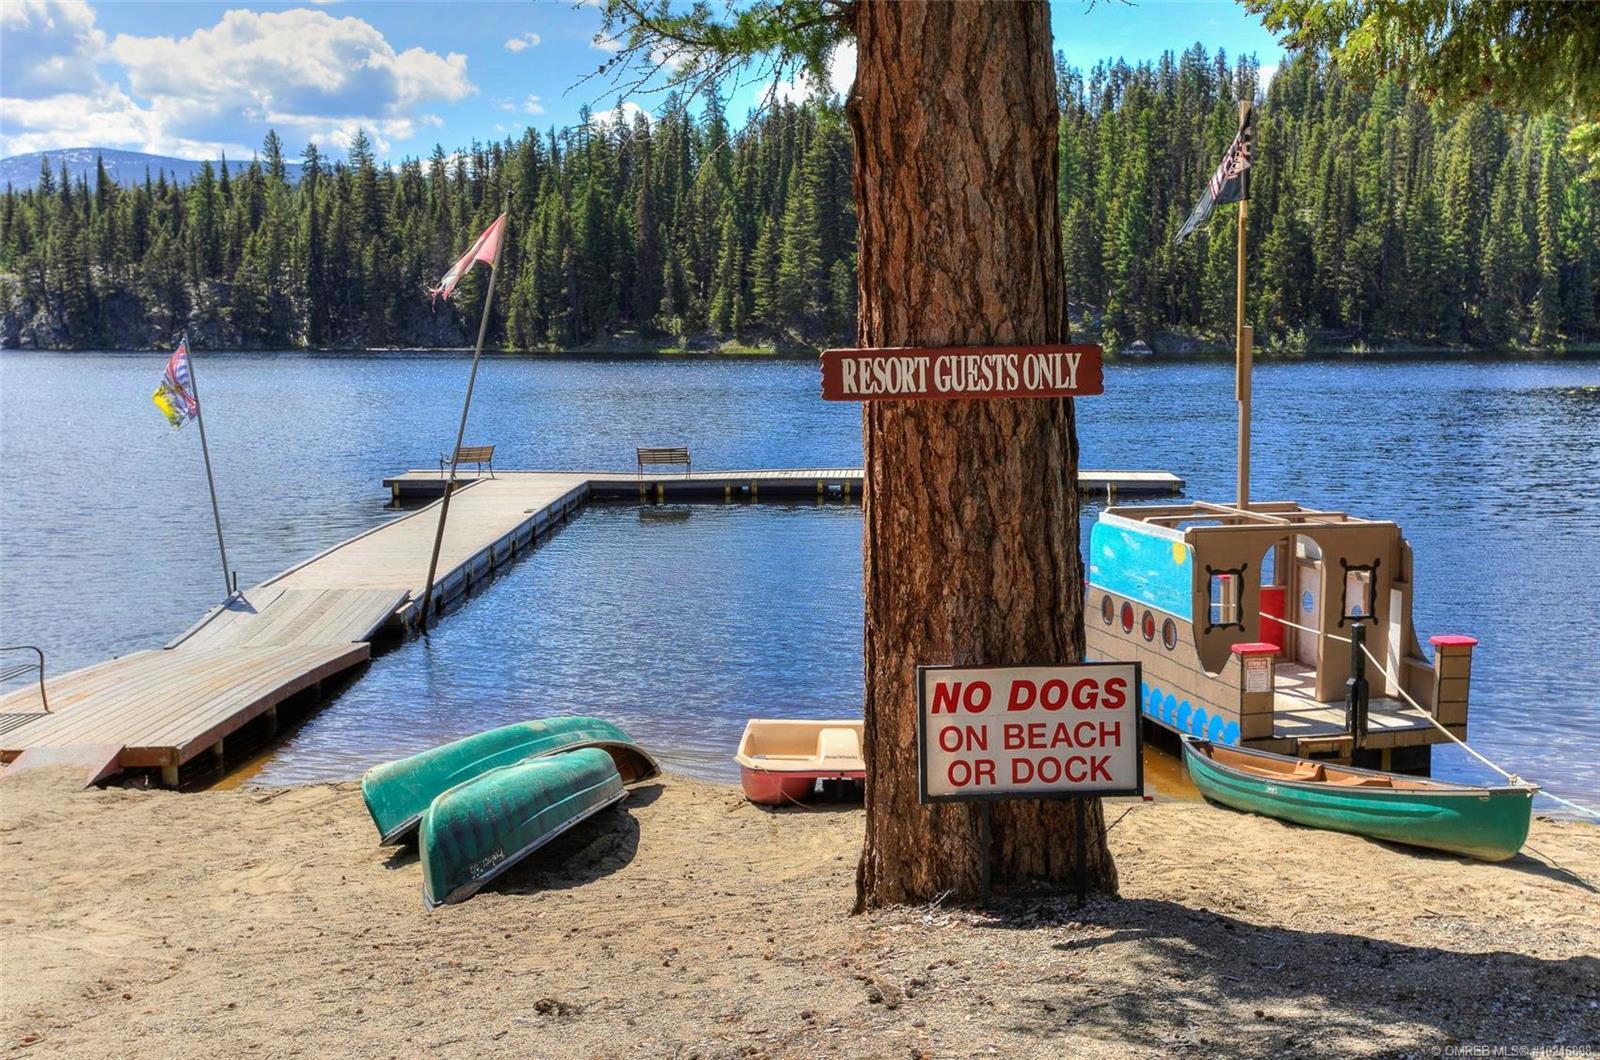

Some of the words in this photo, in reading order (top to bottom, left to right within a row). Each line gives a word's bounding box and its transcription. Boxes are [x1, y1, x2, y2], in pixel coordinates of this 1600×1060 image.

[841, 357, 930, 394] RESORT
[934, 354, 1019, 392] GUESTS
[1022, 353, 1081, 390] ONLY
[931, 681, 992, 714] NO
[1007, 678, 1128, 712] DOGS
[938, 724, 988, 752] ON
[1003, 721, 1121, 750] BEACH
[947, 759, 996, 787] OR
[1011, 755, 1113, 785] DOCK
